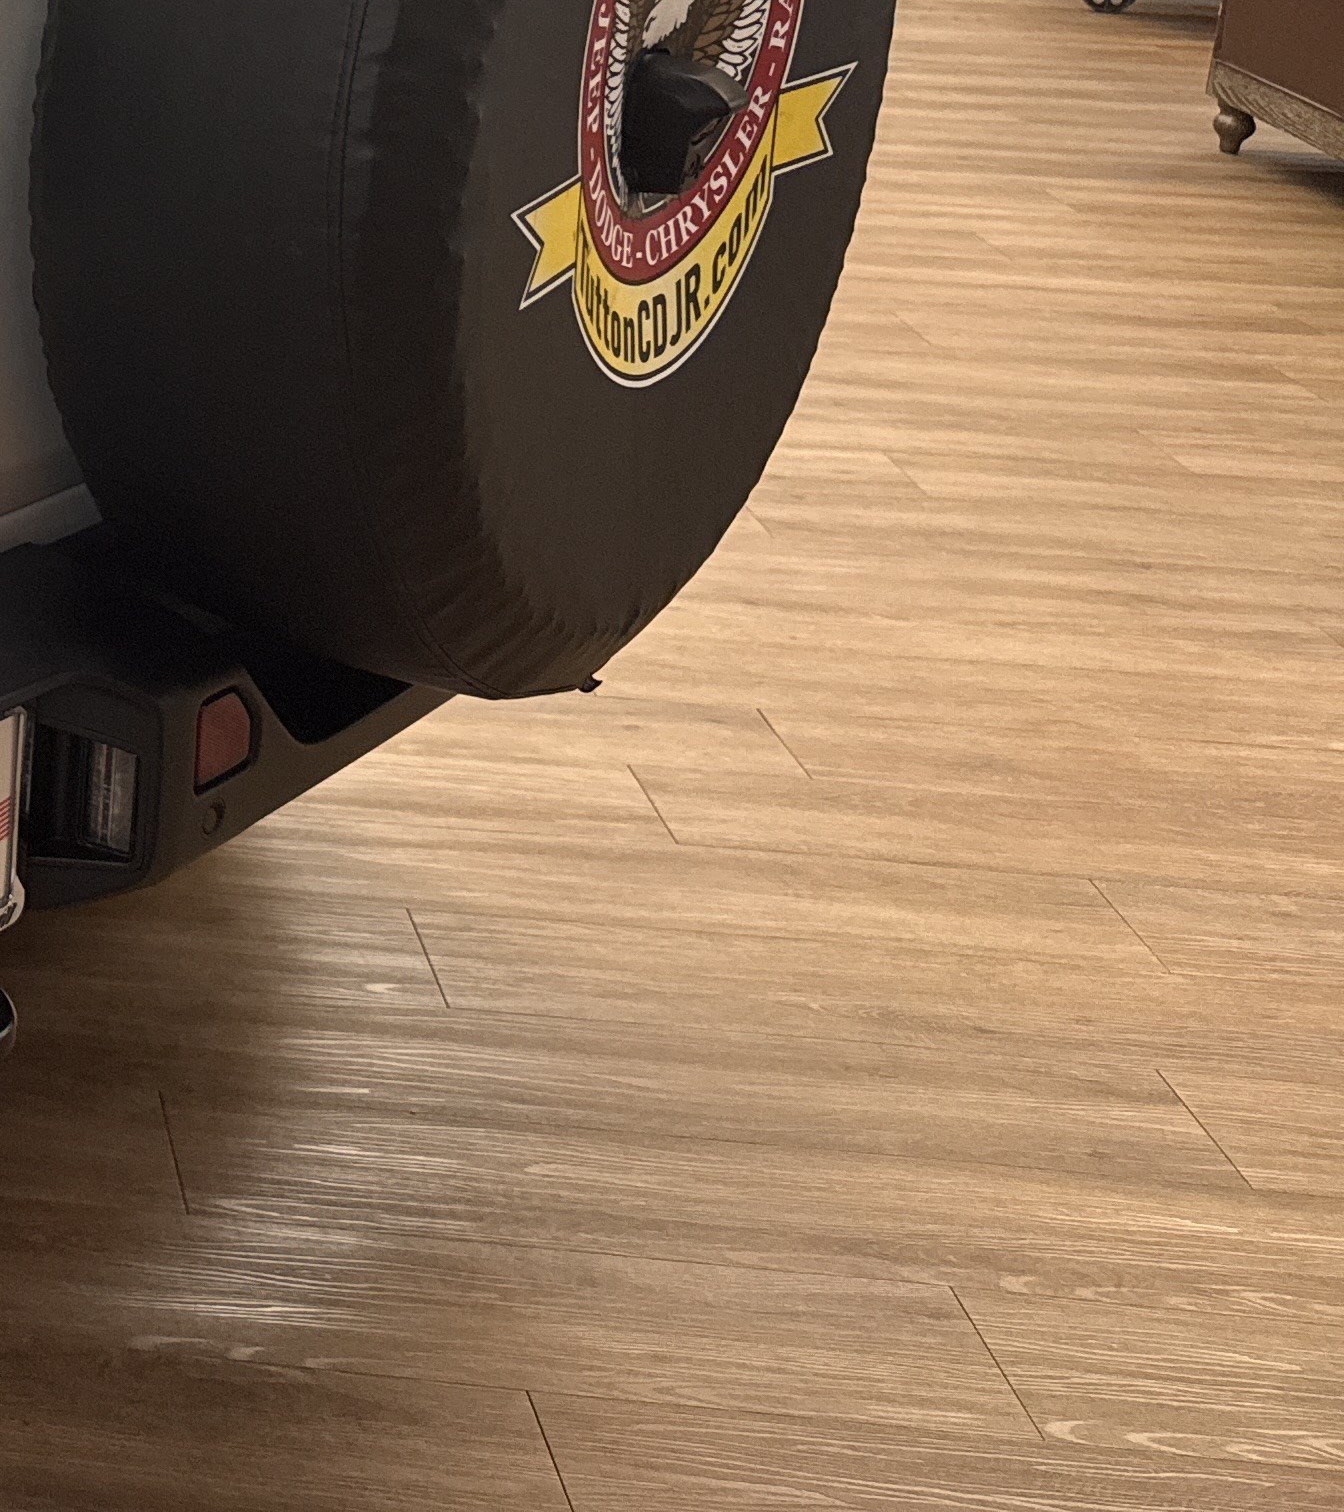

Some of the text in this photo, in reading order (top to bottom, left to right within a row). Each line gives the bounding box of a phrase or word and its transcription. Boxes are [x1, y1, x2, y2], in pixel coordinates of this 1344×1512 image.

[578, 154, 769, 364] TuttonCDJR.com
[588, 162, 635, 269] DODGE
[644, 85, 772, 268] CHRYSLER
